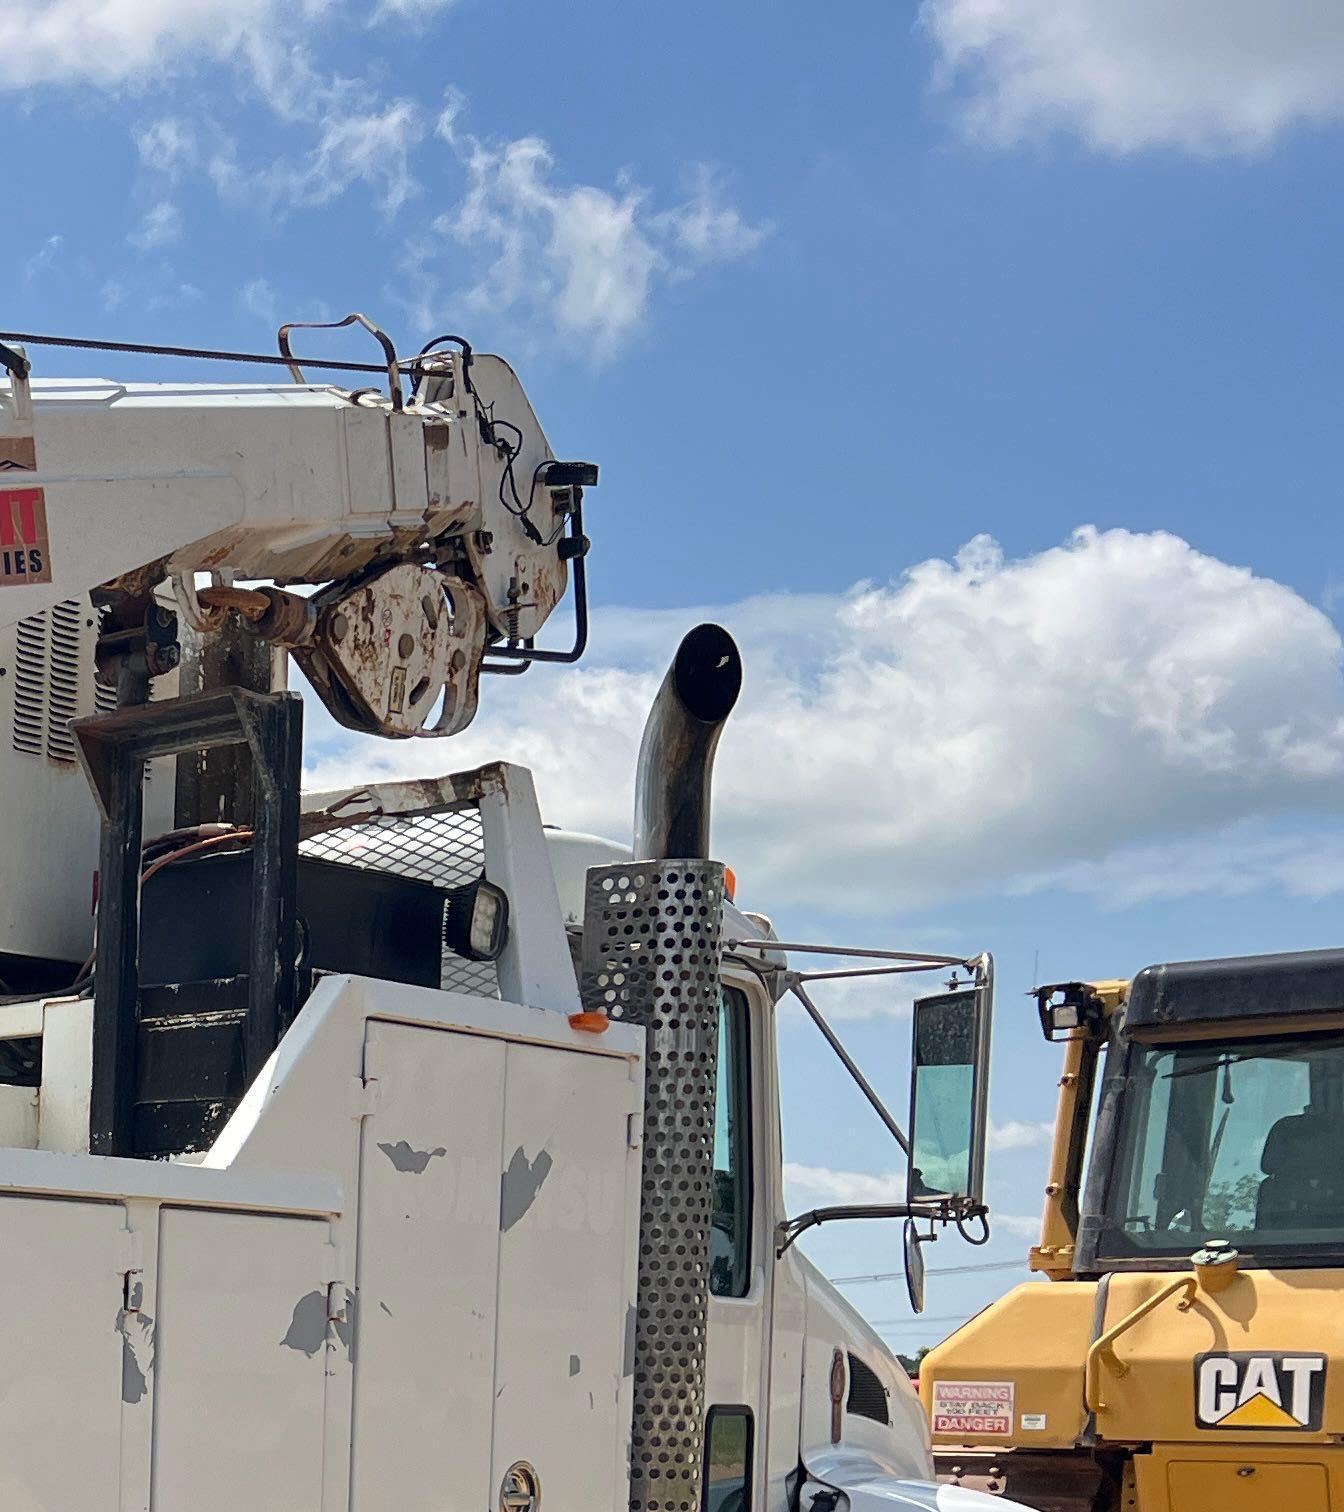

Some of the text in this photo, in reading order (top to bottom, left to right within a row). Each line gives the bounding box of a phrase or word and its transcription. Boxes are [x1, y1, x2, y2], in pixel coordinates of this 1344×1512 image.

[938, 1386, 1009, 1400] WARNING
[1198, 1357, 1324, 1426] CAT
[937, 1416, 1006, 1431] DANGER
